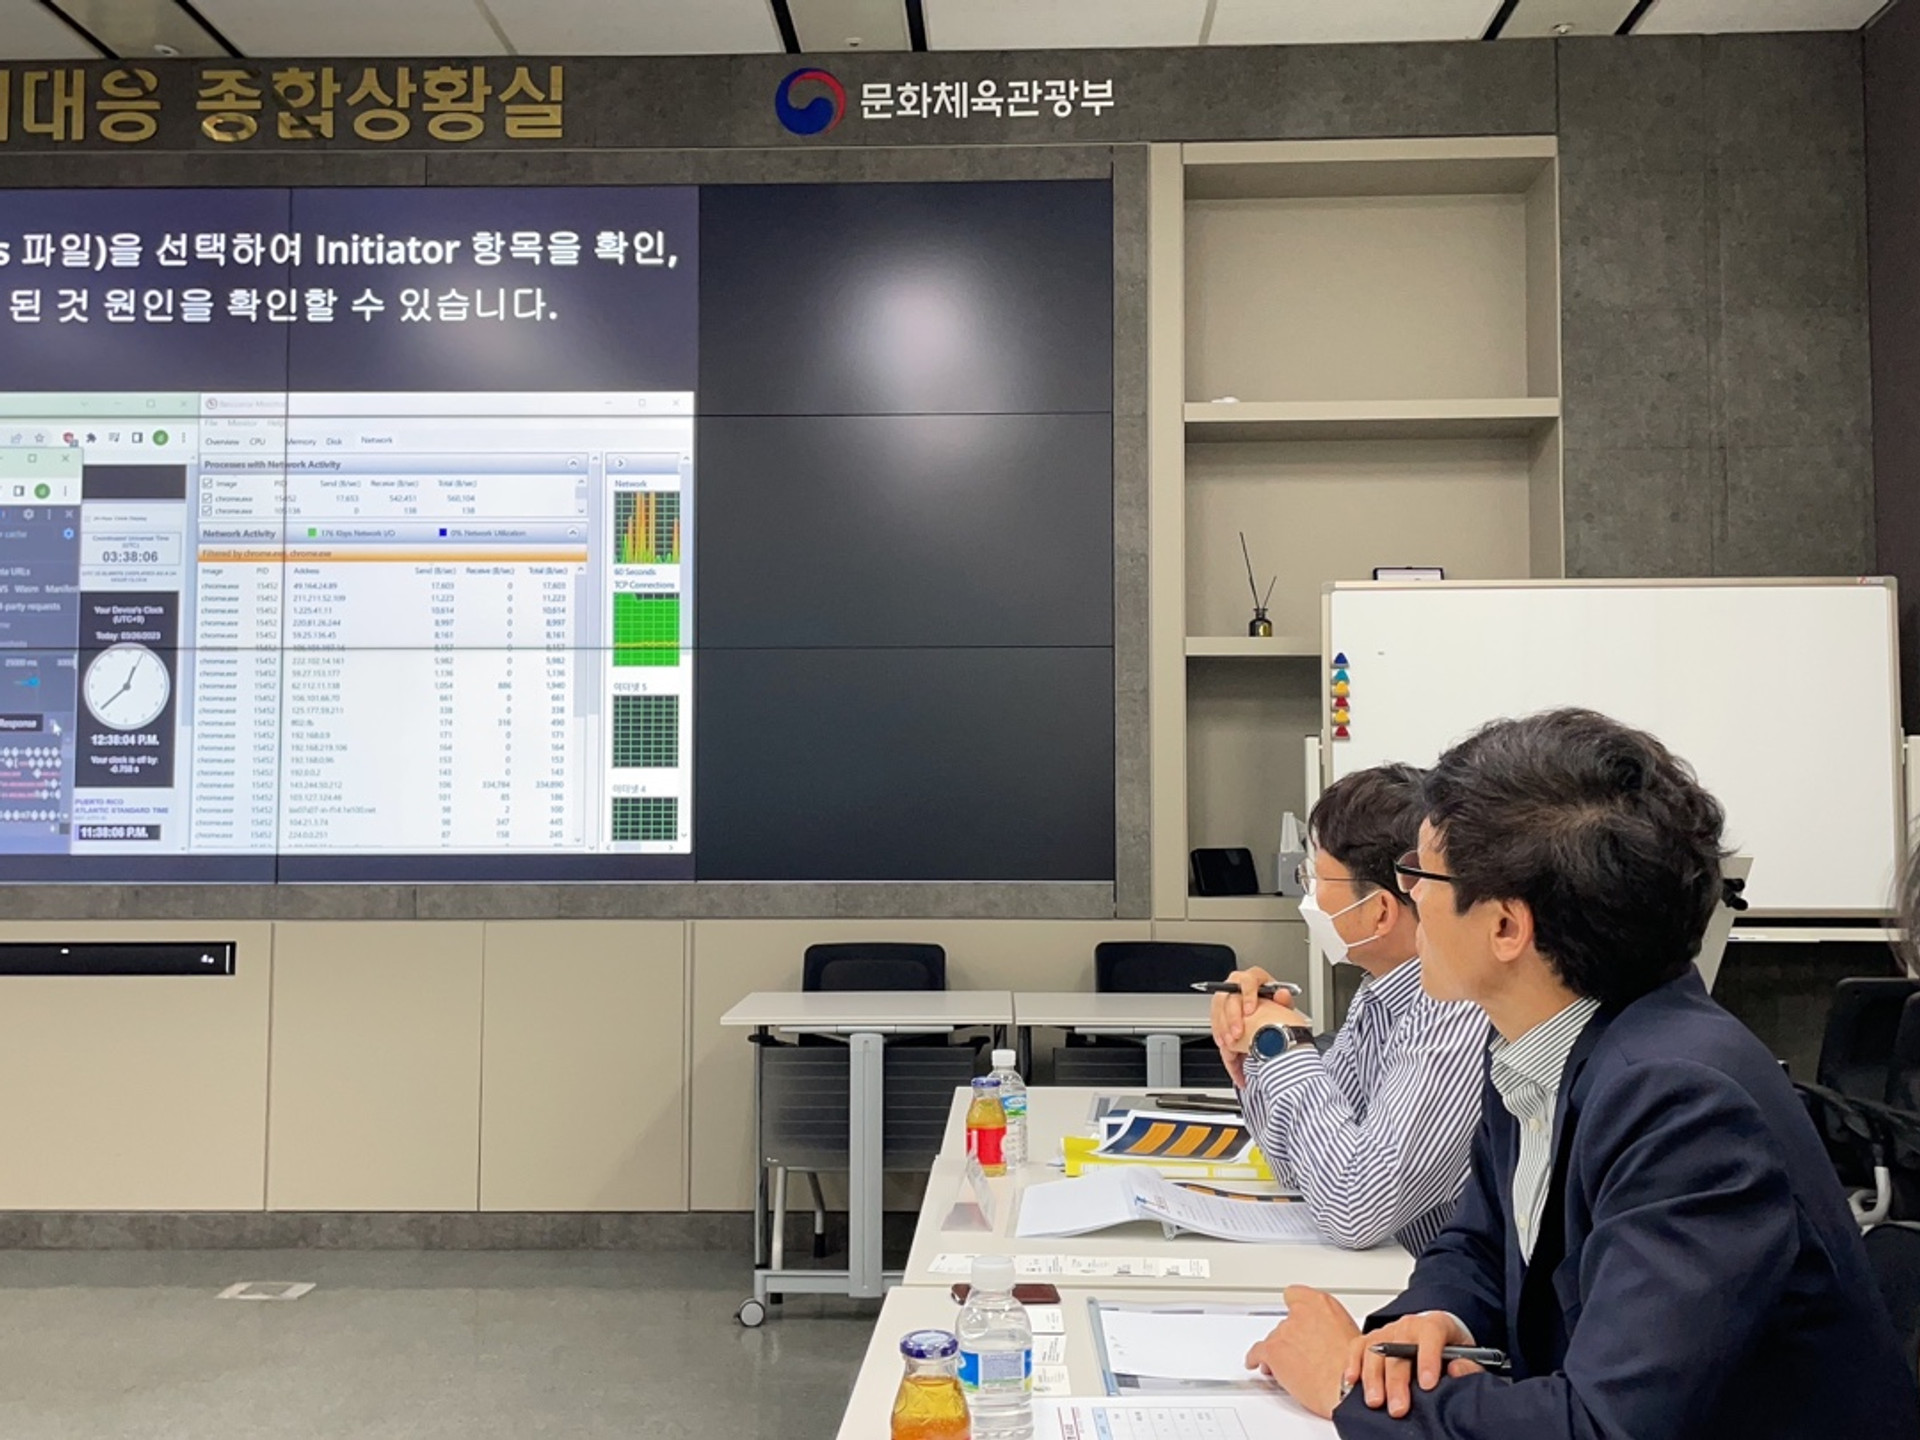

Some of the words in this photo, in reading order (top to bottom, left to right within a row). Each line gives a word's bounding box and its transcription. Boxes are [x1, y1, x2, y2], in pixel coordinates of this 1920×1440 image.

[0, 67, 161, 142] 대응
[196, 65, 564, 141] 종합상황실
[860, 78, 1115, 119] 문화체육관광부
[20, 231, 142, 272] 파일)을
[155, 230, 303, 268] 선택하여
[315, 232, 461, 266] Initiator
[471, 229, 582, 266] 항목을
[593, 228, 680, 270] 확인,
[9, 288, 42, 323] 된
[57, 287, 90, 324] 것
[103, 287, 215, 324] 원인을
[226, 287, 339, 324] 확인할
[351, 287, 386, 323] 수
[399, 286, 558, 323] 있습니다.
[249, 437, 266, 446] CPU
[204, 460, 246, 470] Processes
[247, 460, 266, 469] with
[308, 459, 341, 471] Activity
[615, 480, 647, 488] Network
[203, 529, 239, 539] Network
[240, 529, 276, 540] Activity
[102, 550, 159, 563] 03:38:06
[629, 580, 675, 589] Connections
